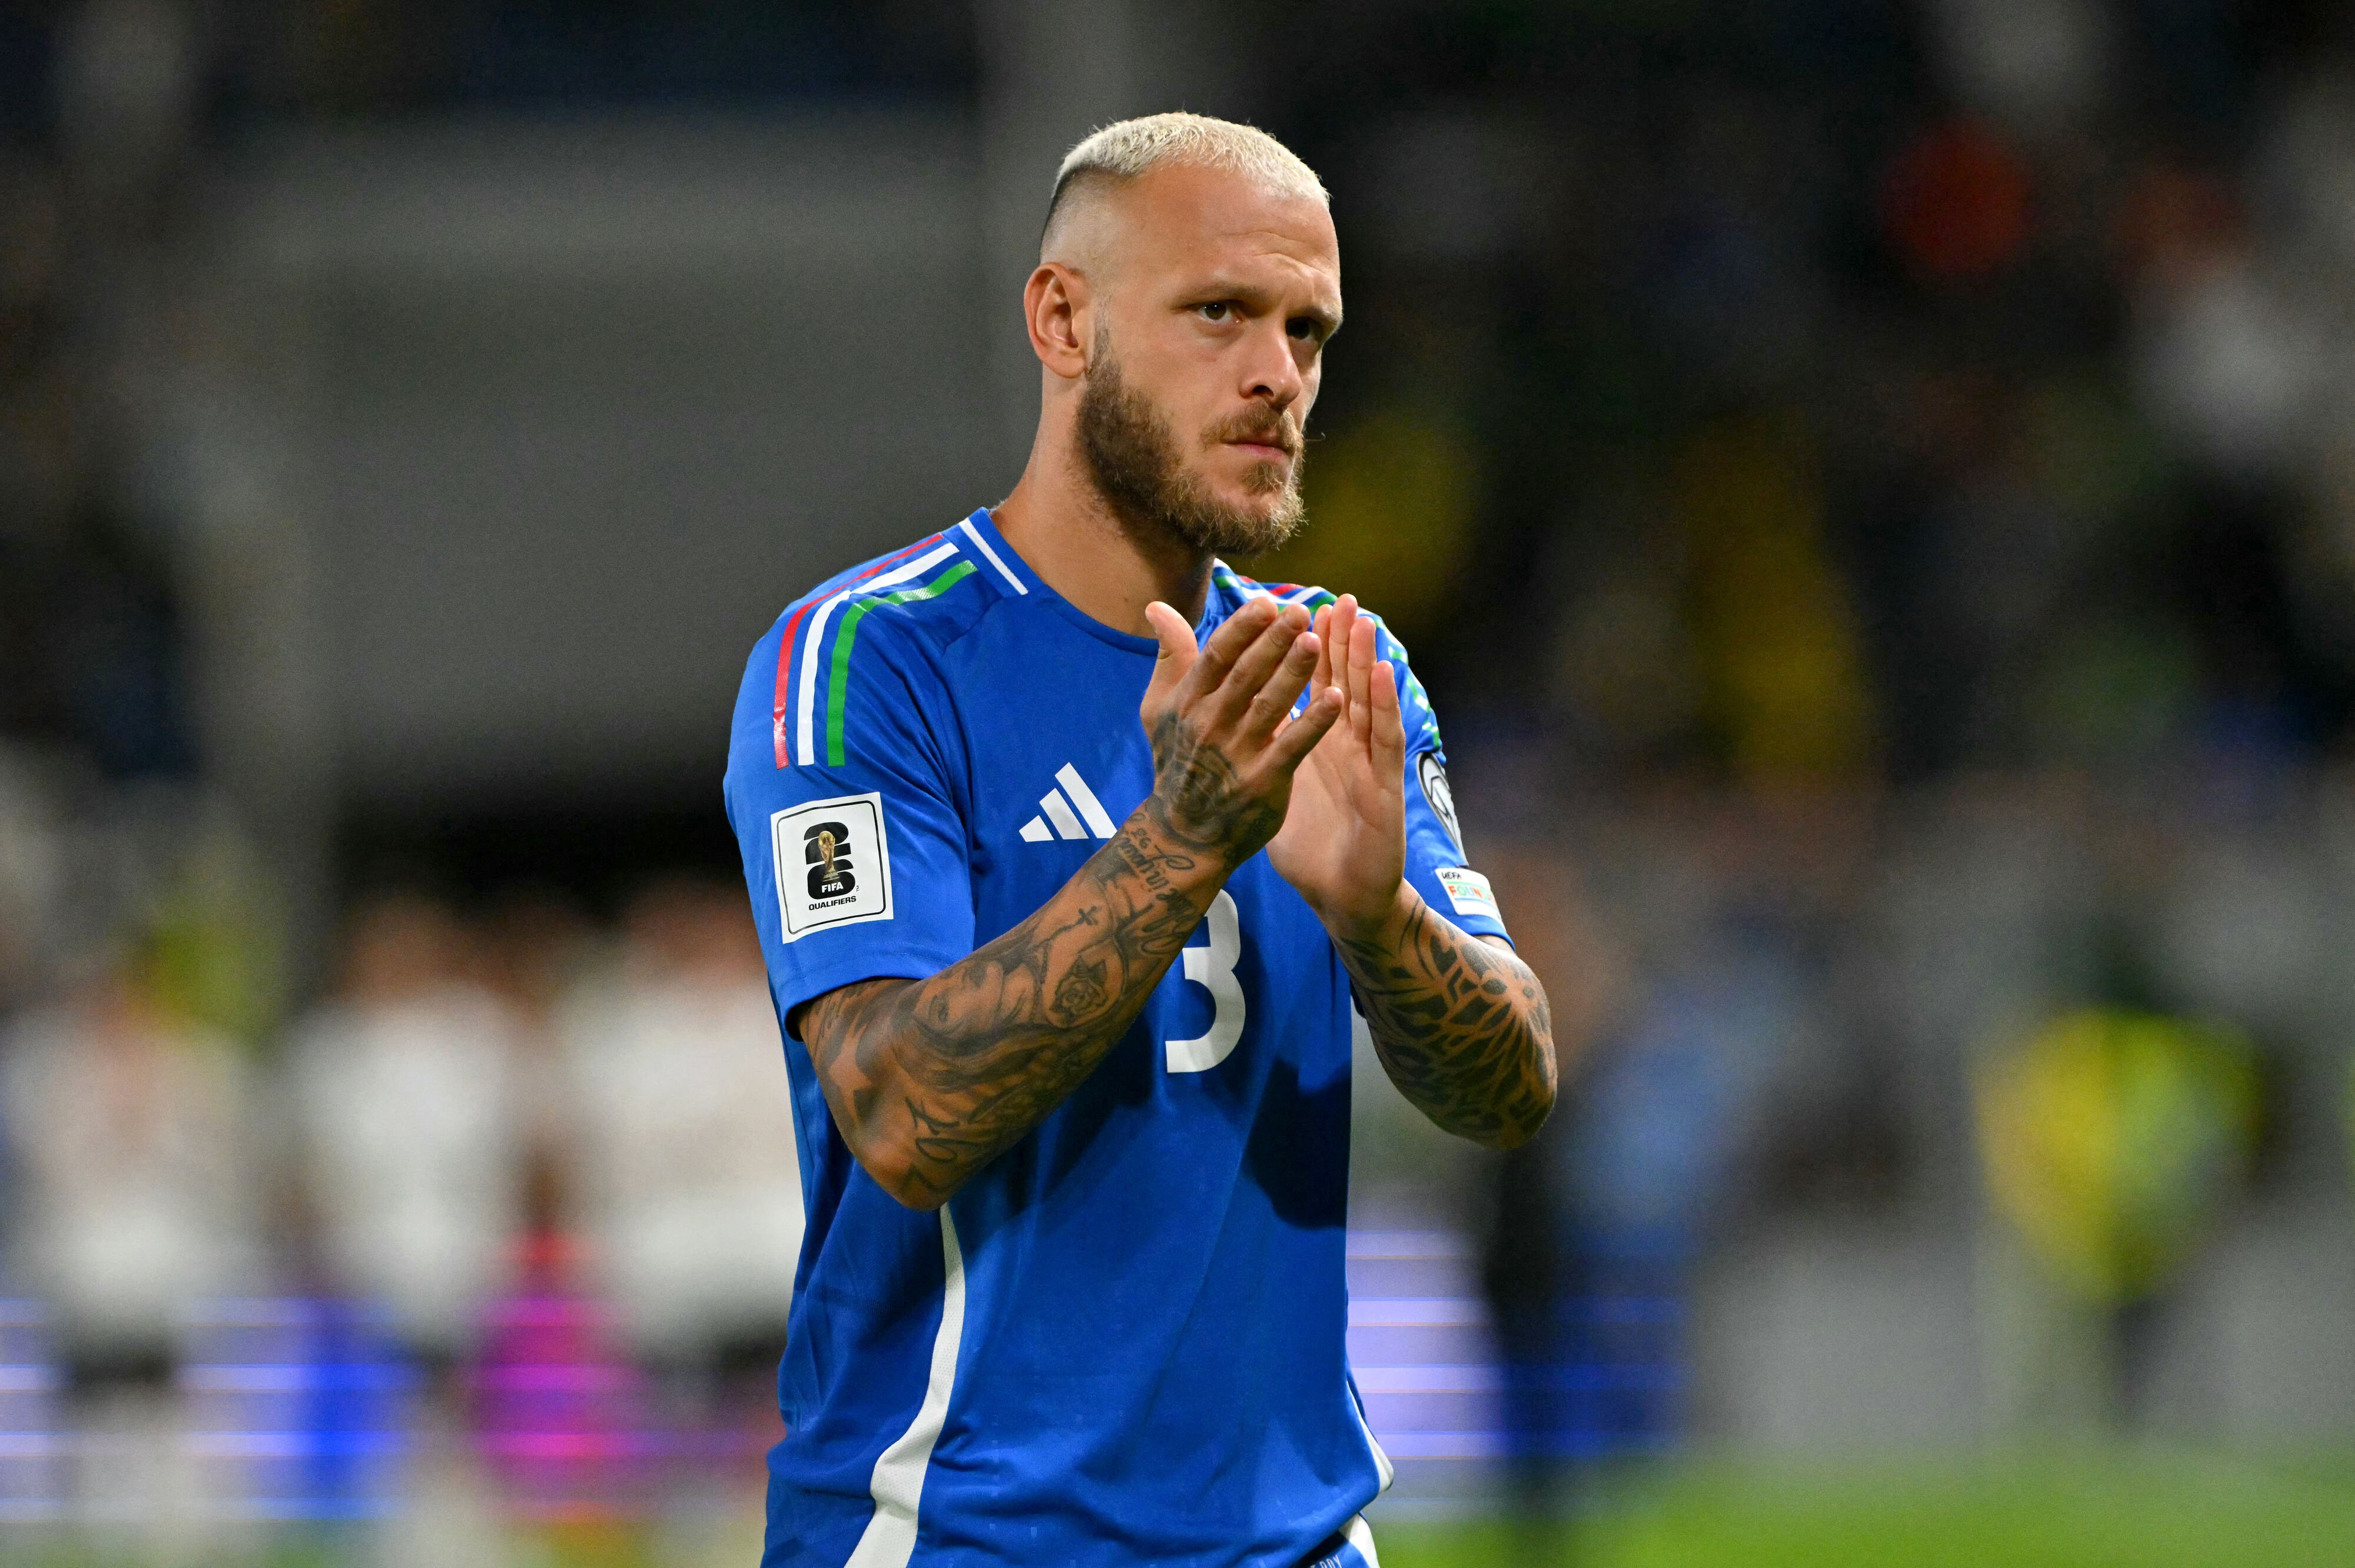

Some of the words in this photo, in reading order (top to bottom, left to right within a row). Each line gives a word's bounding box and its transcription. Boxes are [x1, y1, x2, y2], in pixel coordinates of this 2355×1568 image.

[1441, 871, 1462, 880] UEFA
[821, 882, 844, 893] FIFA
[808, 896, 857, 911] QUALIFIERS
[1165, 888, 1246, 1074] 3
